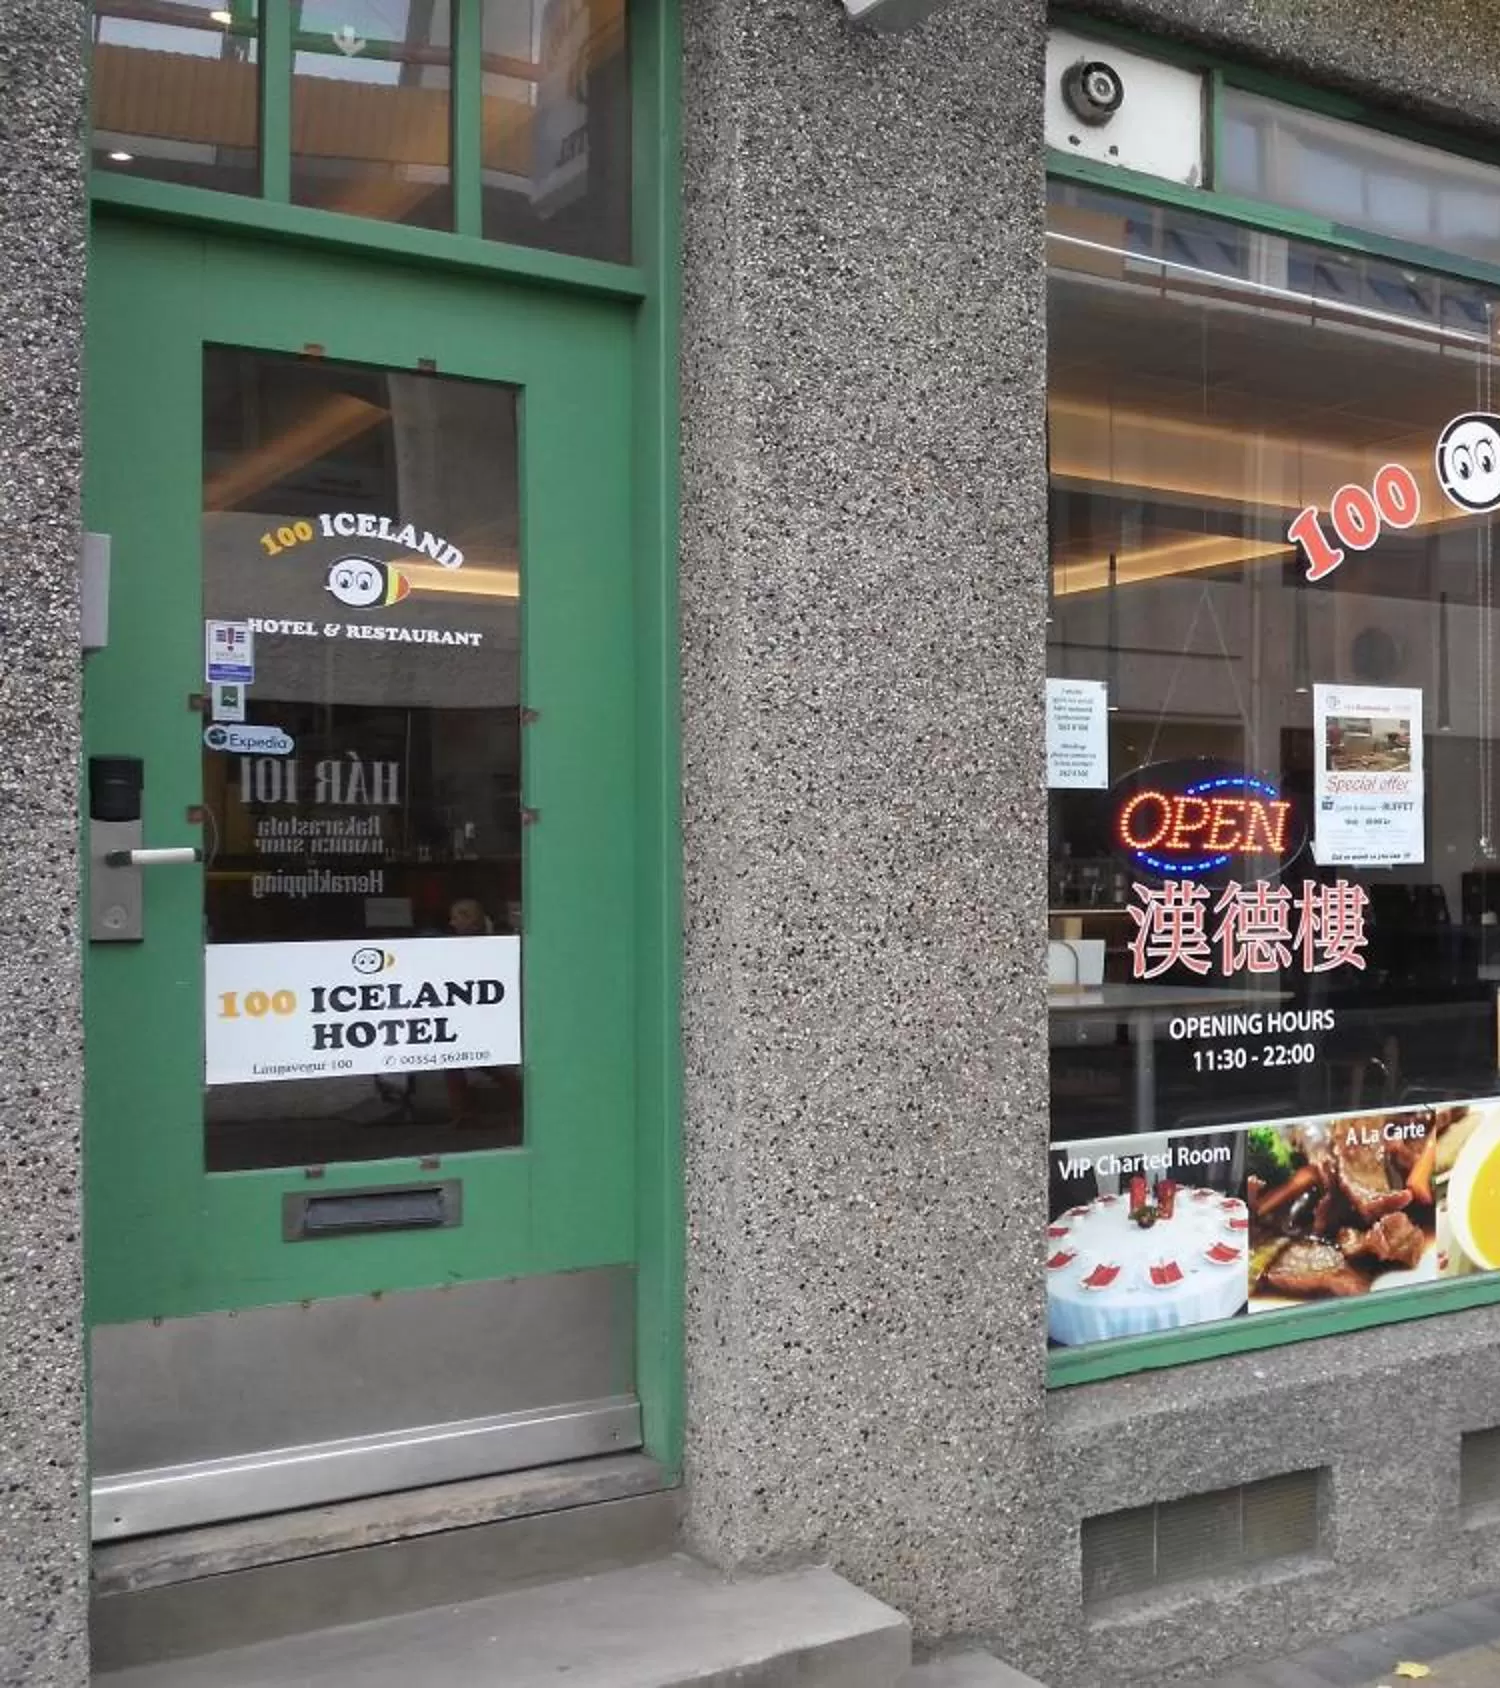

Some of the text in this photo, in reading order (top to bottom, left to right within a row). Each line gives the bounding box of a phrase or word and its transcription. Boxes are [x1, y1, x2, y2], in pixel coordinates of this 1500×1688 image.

[1288, 463, 1420, 581] 100
[259, 512, 464, 569] 100 ICELAND
[249, 617, 482, 646] HOTEL & RESTAURANT
[229, 732, 287, 750] Expedia
[1326, 775, 1376, 794] Special
[1120, 791, 1290, 854] OPEN
[1126, 879, 1369, 979] 漢德樓
[218, 979, 505, 1017] 100 ICELAND
[312, 1018, 458, 1050] HOTEL
[1169, 1009, 1335, 1040] OPENING HOURS
[253, 1059, 353, 1076] Laugavegur 100
[1193, 1049, 1246, 1073] 11:30
[1263, 1043, 1315, 1067] 22:00
[1346, 1120, 1426, 1145] A La Carte
[1059, 1144, 1232, 1182] VIP Charted Room
